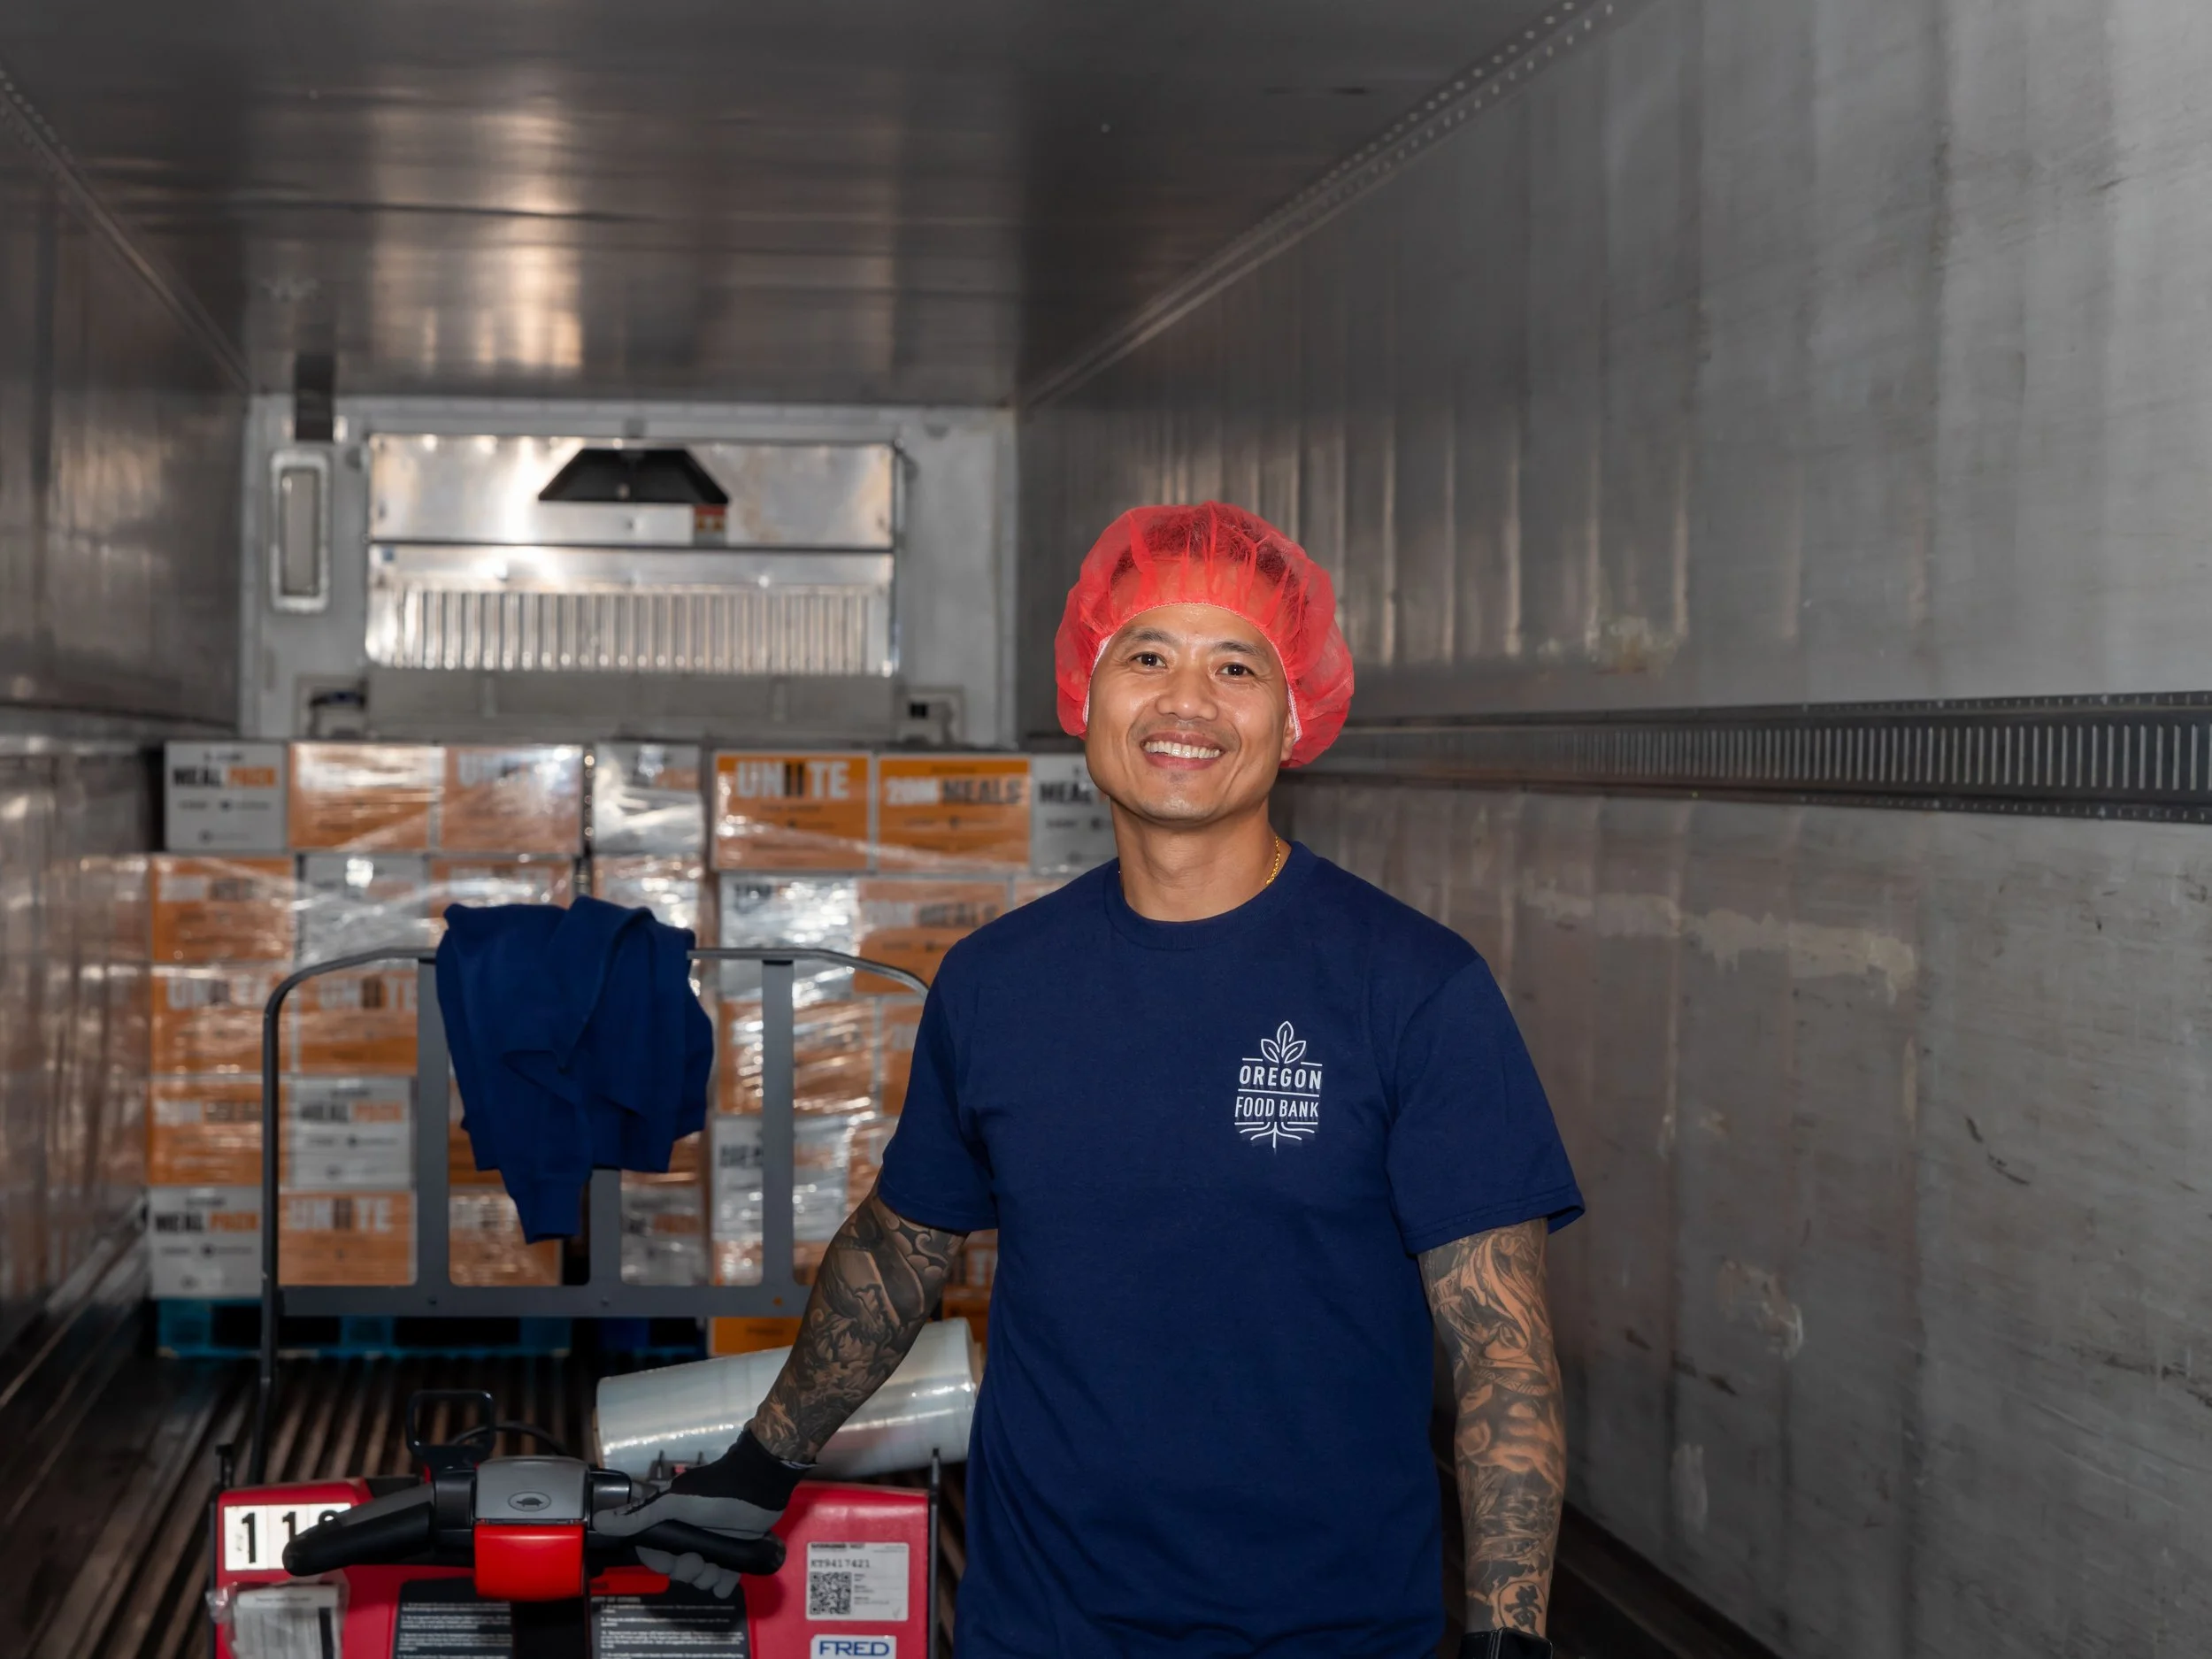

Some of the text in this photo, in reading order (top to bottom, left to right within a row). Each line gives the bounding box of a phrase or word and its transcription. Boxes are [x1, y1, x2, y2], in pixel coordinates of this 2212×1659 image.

[1239, 1065, 1323, 1090] OREGON
[1234, 1096, 1319, 1118] FOOD BANK
[819, 1640, 890, 1657] FRED
